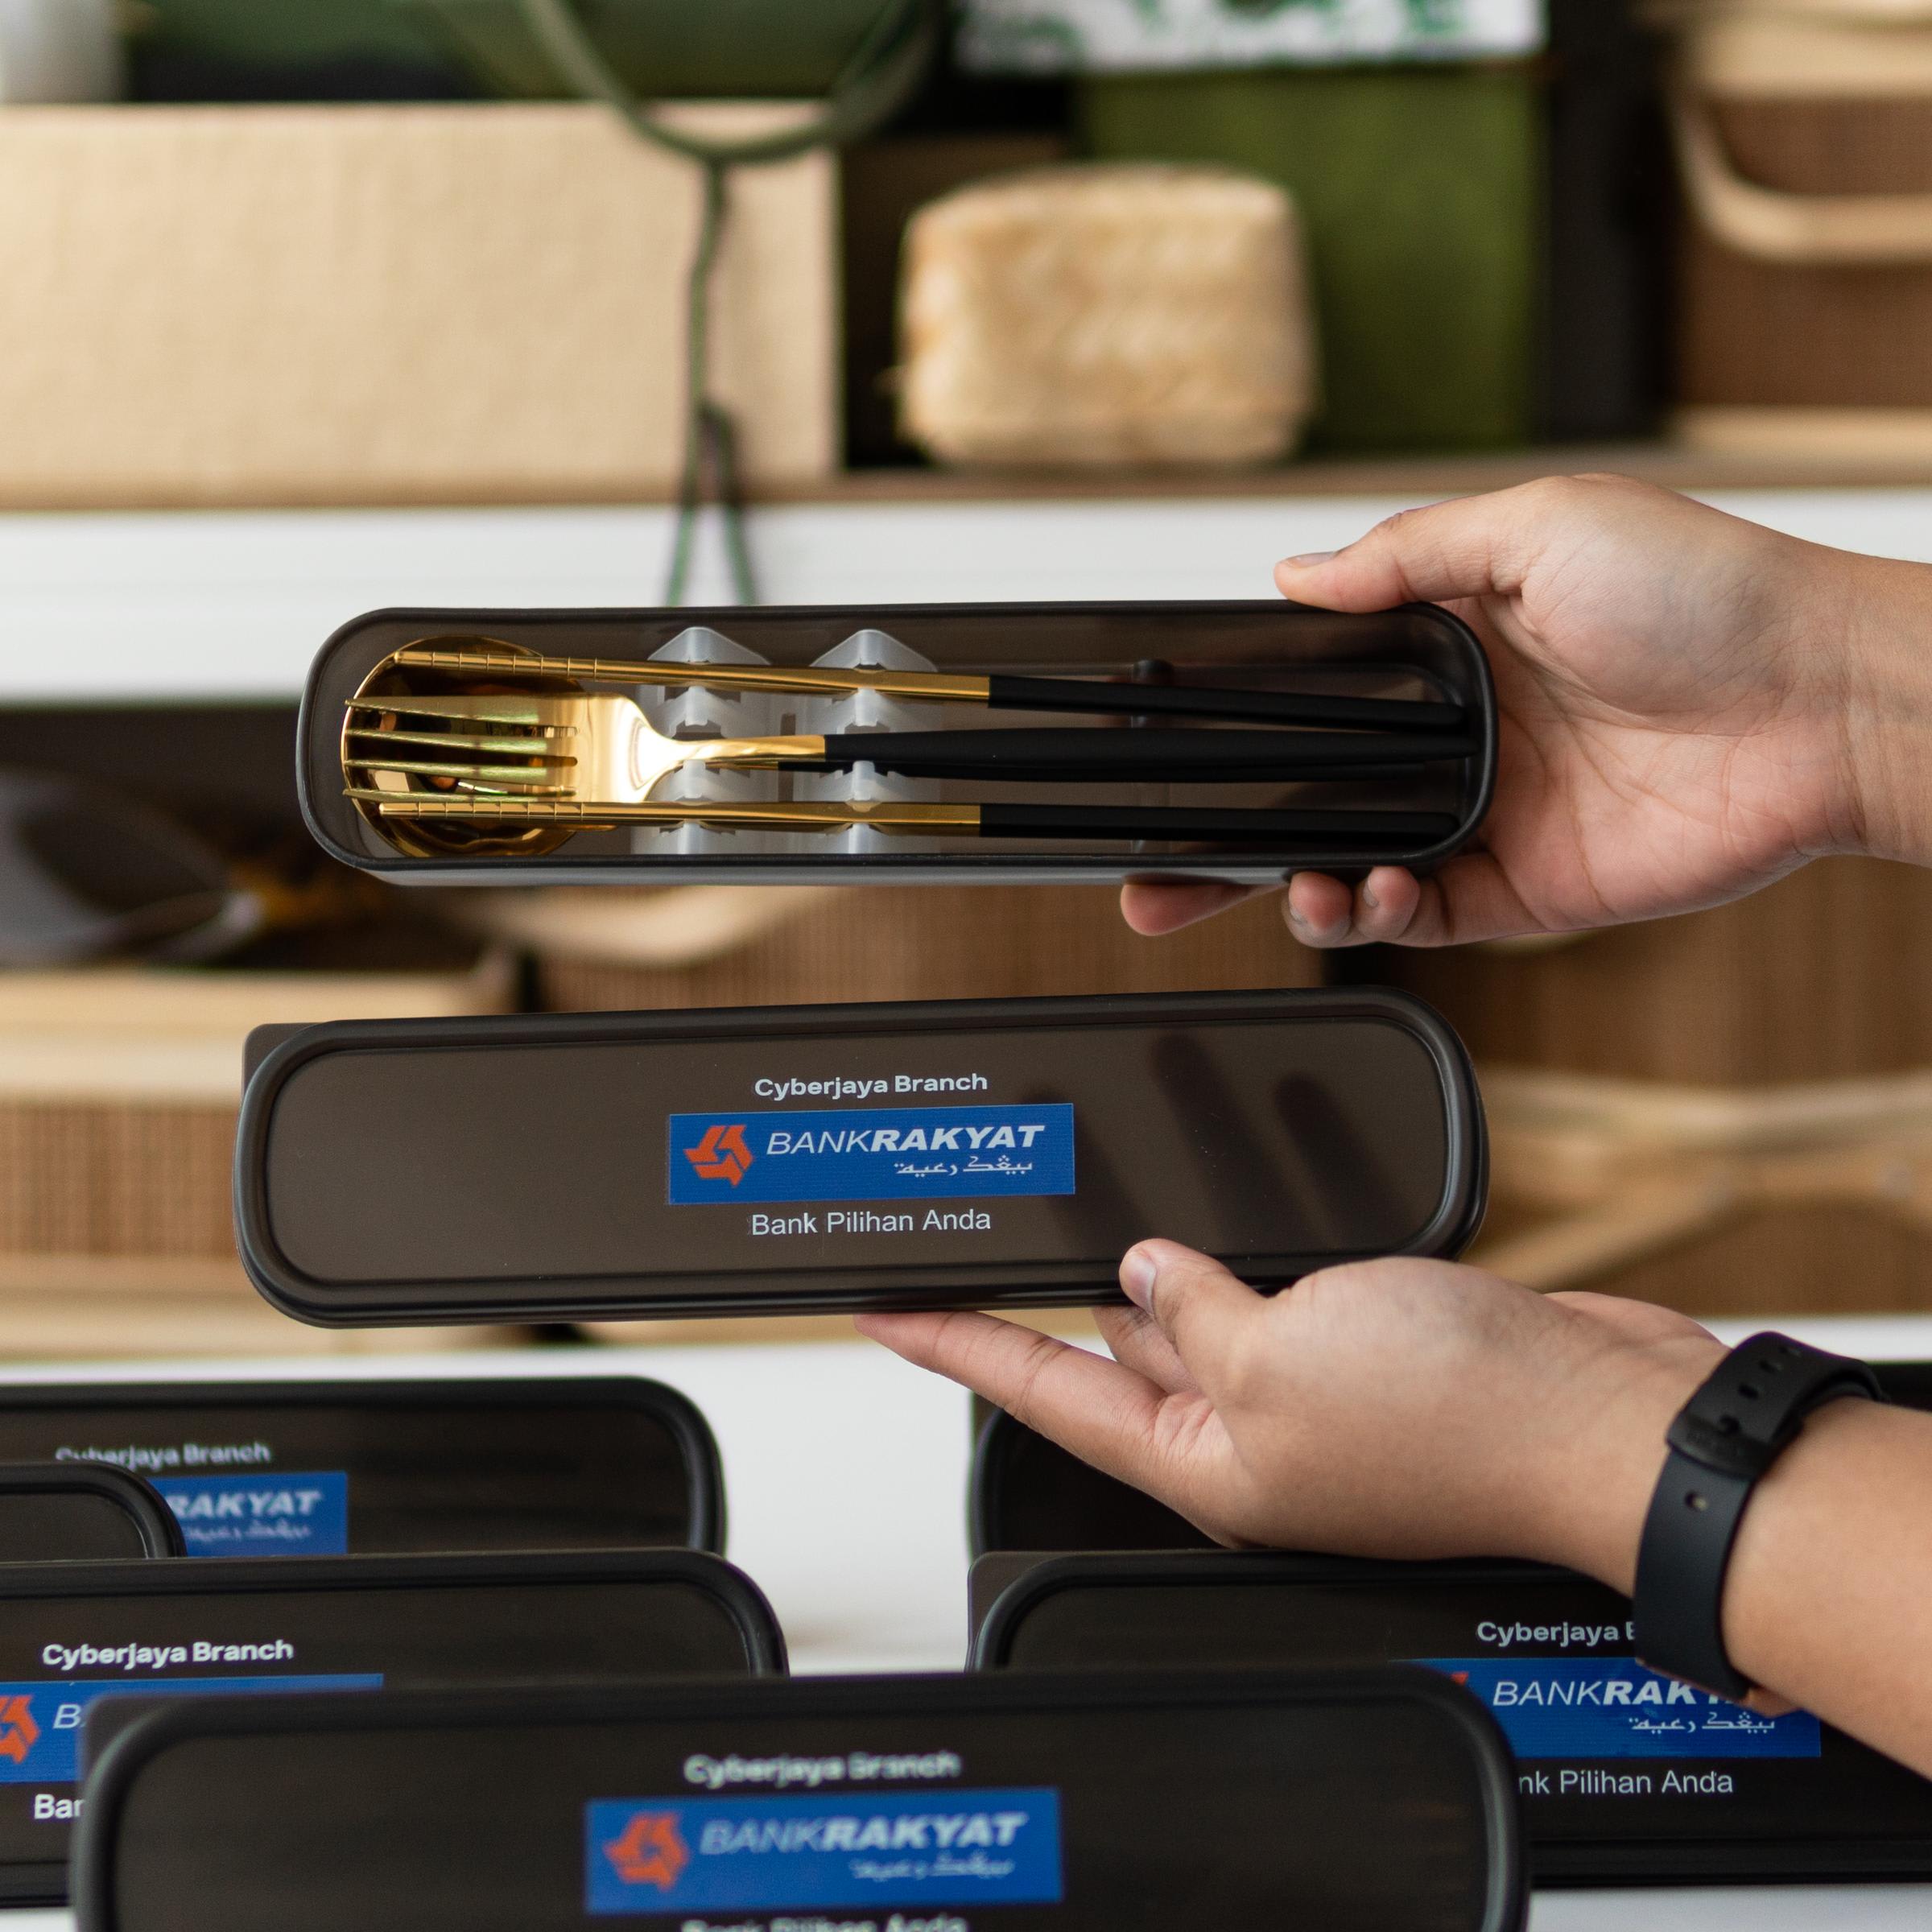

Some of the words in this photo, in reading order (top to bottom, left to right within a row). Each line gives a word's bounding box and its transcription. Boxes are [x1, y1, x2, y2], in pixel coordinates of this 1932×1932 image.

[755, 1078, 888, 1100] Cyberjaya
[895, 1073, 987, 1092] Branch
[767, 1125, 1044, 1154] BANKRAKYAT
[752, 1213, 817, 1235] Bank
[827, 1211, 914, 1232] Pilihan
[923, 1209, 990, 1231] Anda
[184, 1442, 270, 1463] Branch
[1477, 1622, 1618, 1647] Cyberjaya
[43, 1643, 187, 1670] Cyberjaya
[192, 1639, 294, 1662] Branch
[1560, 1770, 1651, 1794] Pilihan
[1661, 1770, 1733, 1794] Anda
